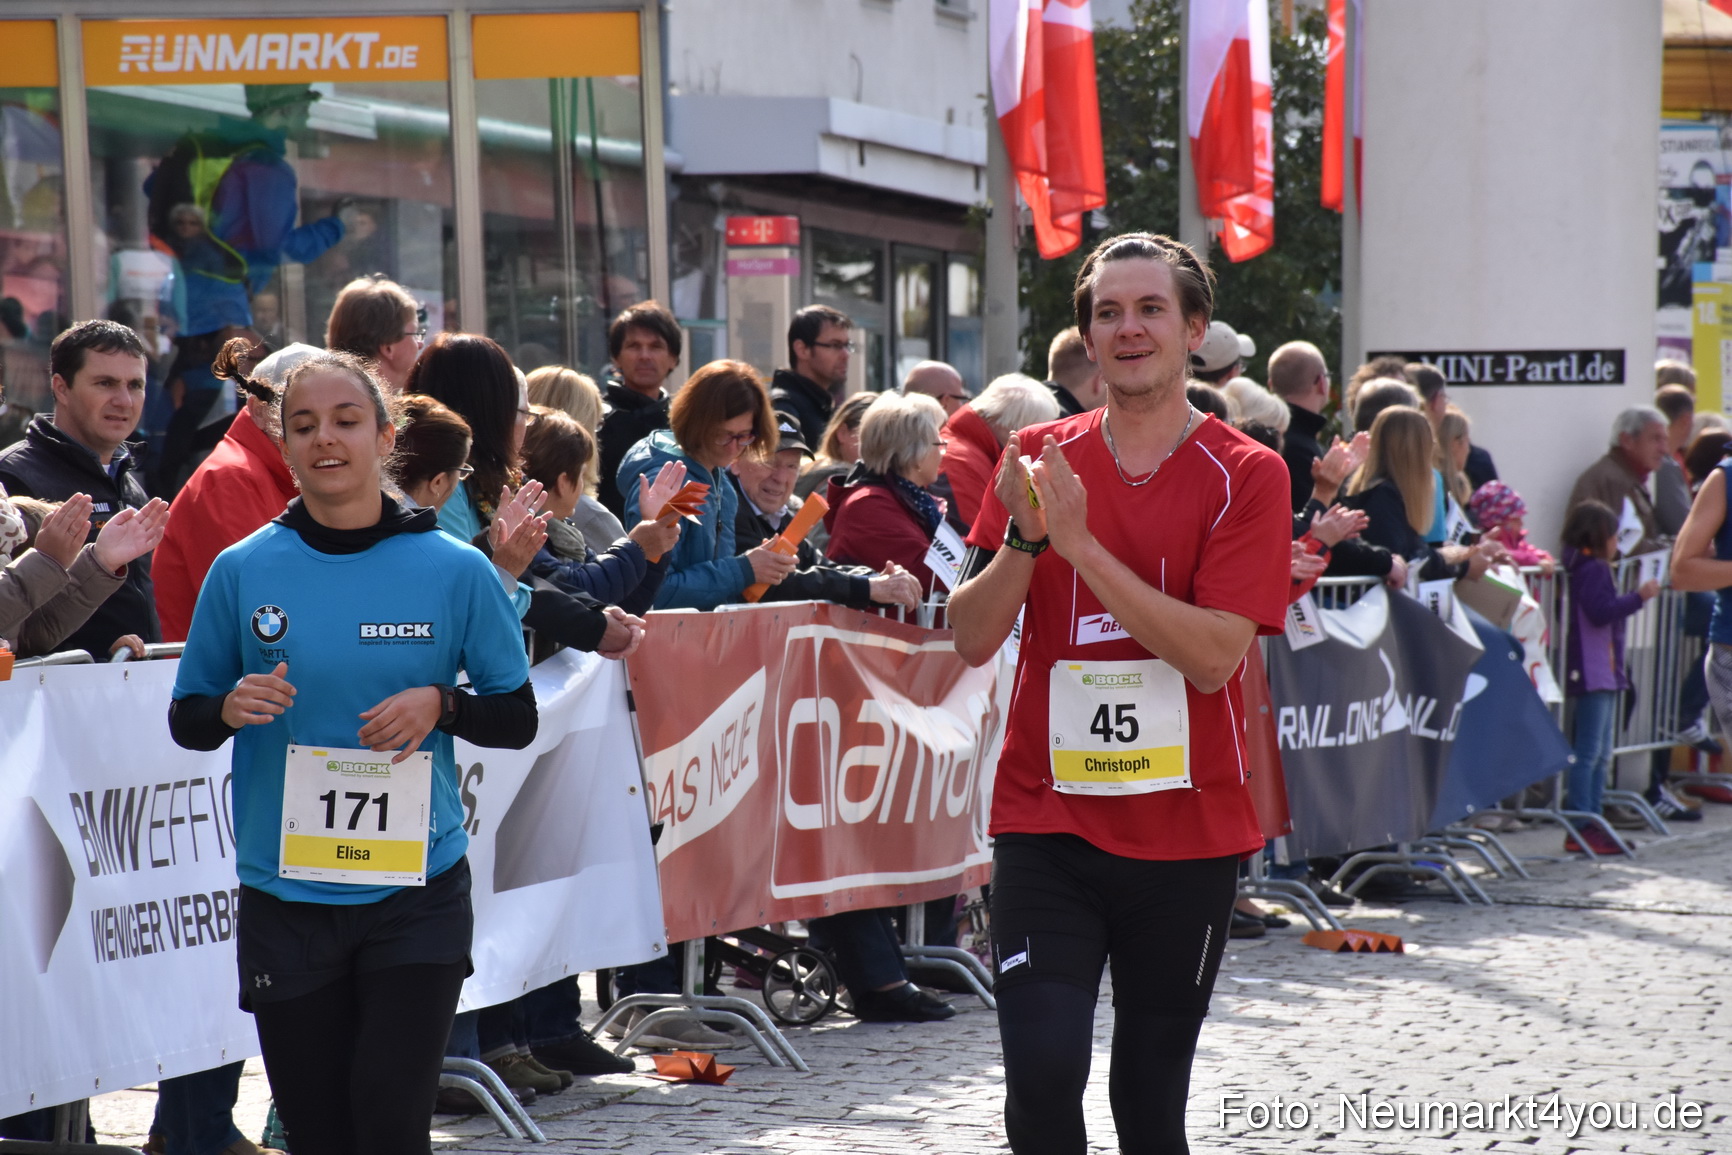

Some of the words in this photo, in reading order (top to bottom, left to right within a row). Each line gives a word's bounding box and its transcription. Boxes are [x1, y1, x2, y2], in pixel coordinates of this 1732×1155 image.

[119, 32, 418, 72] RUNMARKT.DE
[254, 606, 286, 619] BMW
[359, 622, 434, 639] BOCK
[1094, 673, 1143, 686] BOCK
[1089, 703, 1140, 744] 45
[1278, 697, 1382, 751] RAIL.ONE
[1055, 736, 1061, 745] D
[708, 700, 756, 808] NEUE
[340, 761, 391, 775] BOCK
[1084, 756, 1151, 774] Christoph
[319, 789, 389, 832] 171
[69, 785, 149, 878] BMW
[289, 821, 295, 829] D
[336, 845, 371, 861] Elisa
[91, 900, 166, 964] WENIGER
